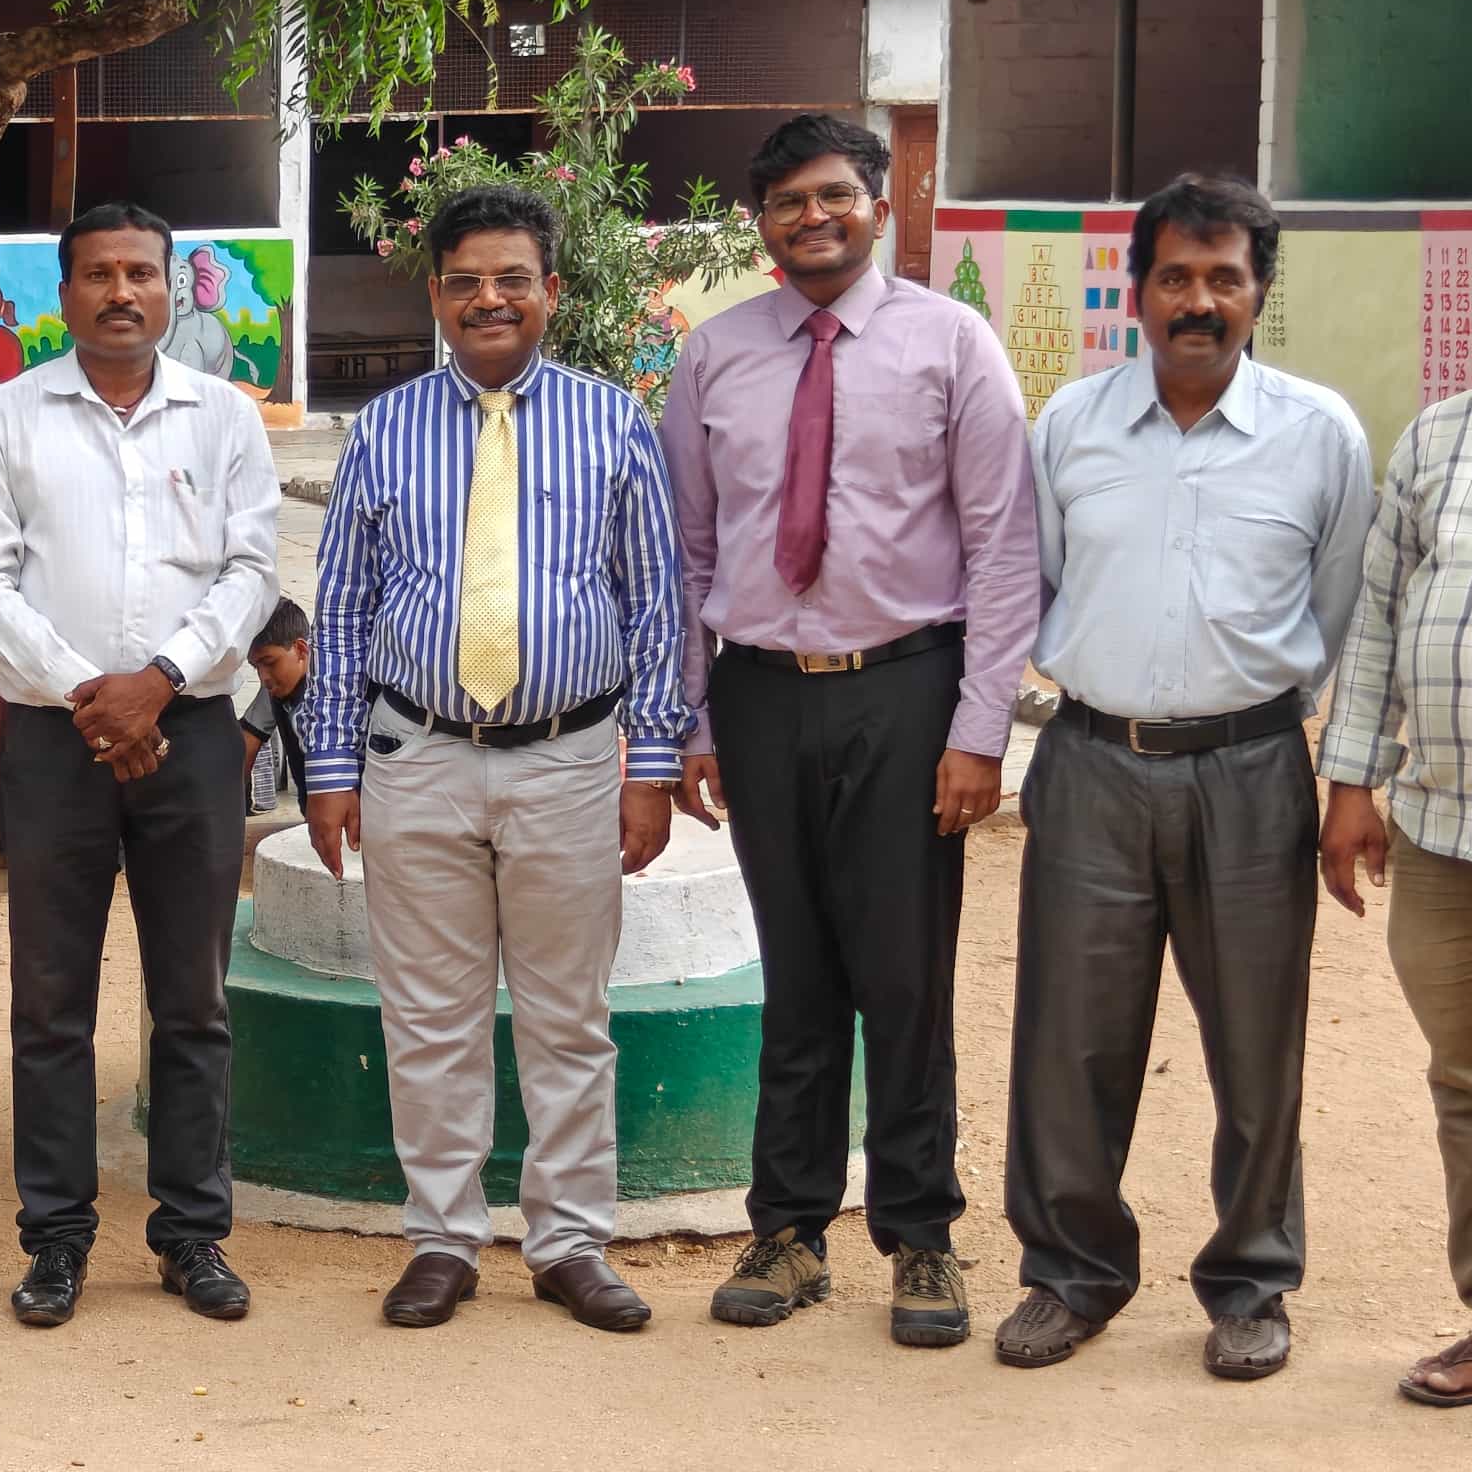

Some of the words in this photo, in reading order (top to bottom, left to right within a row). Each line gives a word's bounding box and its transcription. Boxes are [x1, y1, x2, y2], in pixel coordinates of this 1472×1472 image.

[1428, 247, 1432, 265] 1
[1441, 247, 1449, 265] 11
[1457, 247, 1467, 265] 21
[1425, 270, 1432, 288] 2
[1441, 270, 1450, 288] 12
[1456, 270, 1469, 288] 22
[1424, 294, 1433, 312] 3
[1440, 294, 1452, 312] 13
[1456, 294, 1470, 312] 23
[1424, 316, 1432, 335] 4
[1440, 316, 1450, 335] 14
[1456, 317, 1470, 336] 24
[1424, 337, 1433, 357] 5
[1440, 339, 1451, 358] 15
[1455, 340, 1469, 359] 25
[1423, 361, 1431, 380] 6
[1439, 361, 1449, 380] 16
[1455, 362, 1466, 381] 26
[1423, 386, 1431, 405] 7
